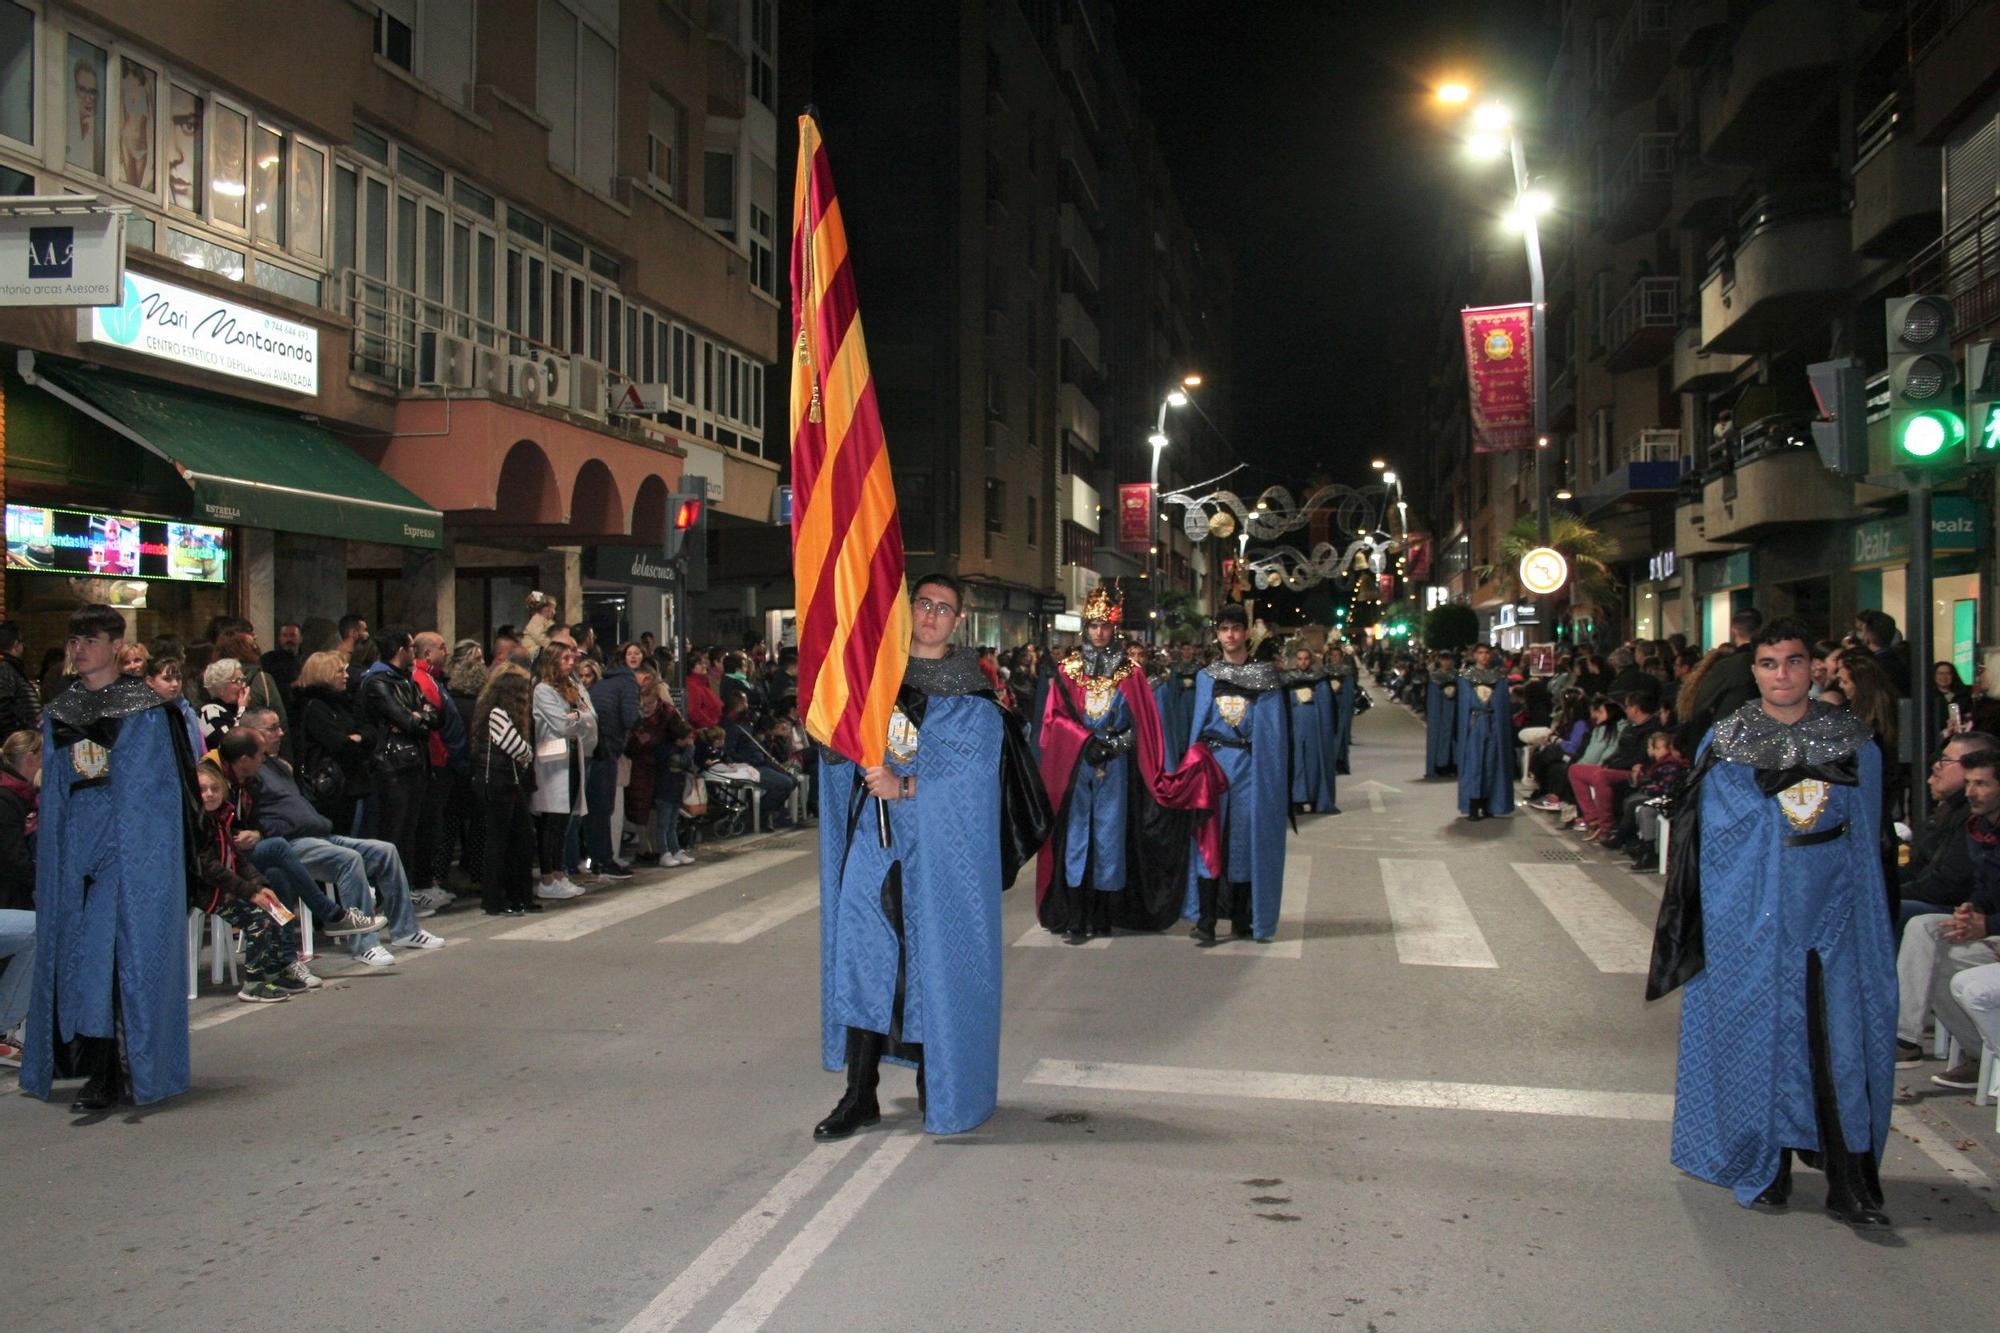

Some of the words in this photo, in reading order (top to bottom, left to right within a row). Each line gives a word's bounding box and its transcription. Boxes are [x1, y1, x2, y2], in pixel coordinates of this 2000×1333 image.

[33, 286, 62, 294] arcas
[65, 284, 109, 294] Asesores
[193, 309, 313, 363] Montaranda
[146, 336, 181, 355] CENTRO
[220, 354, 225, 368] Y
[273, 368, 312, 388] AVANZADA
[206, 504, 240, 517] ESTRELLA
[1855, 527, 1891, 562] Dealz
